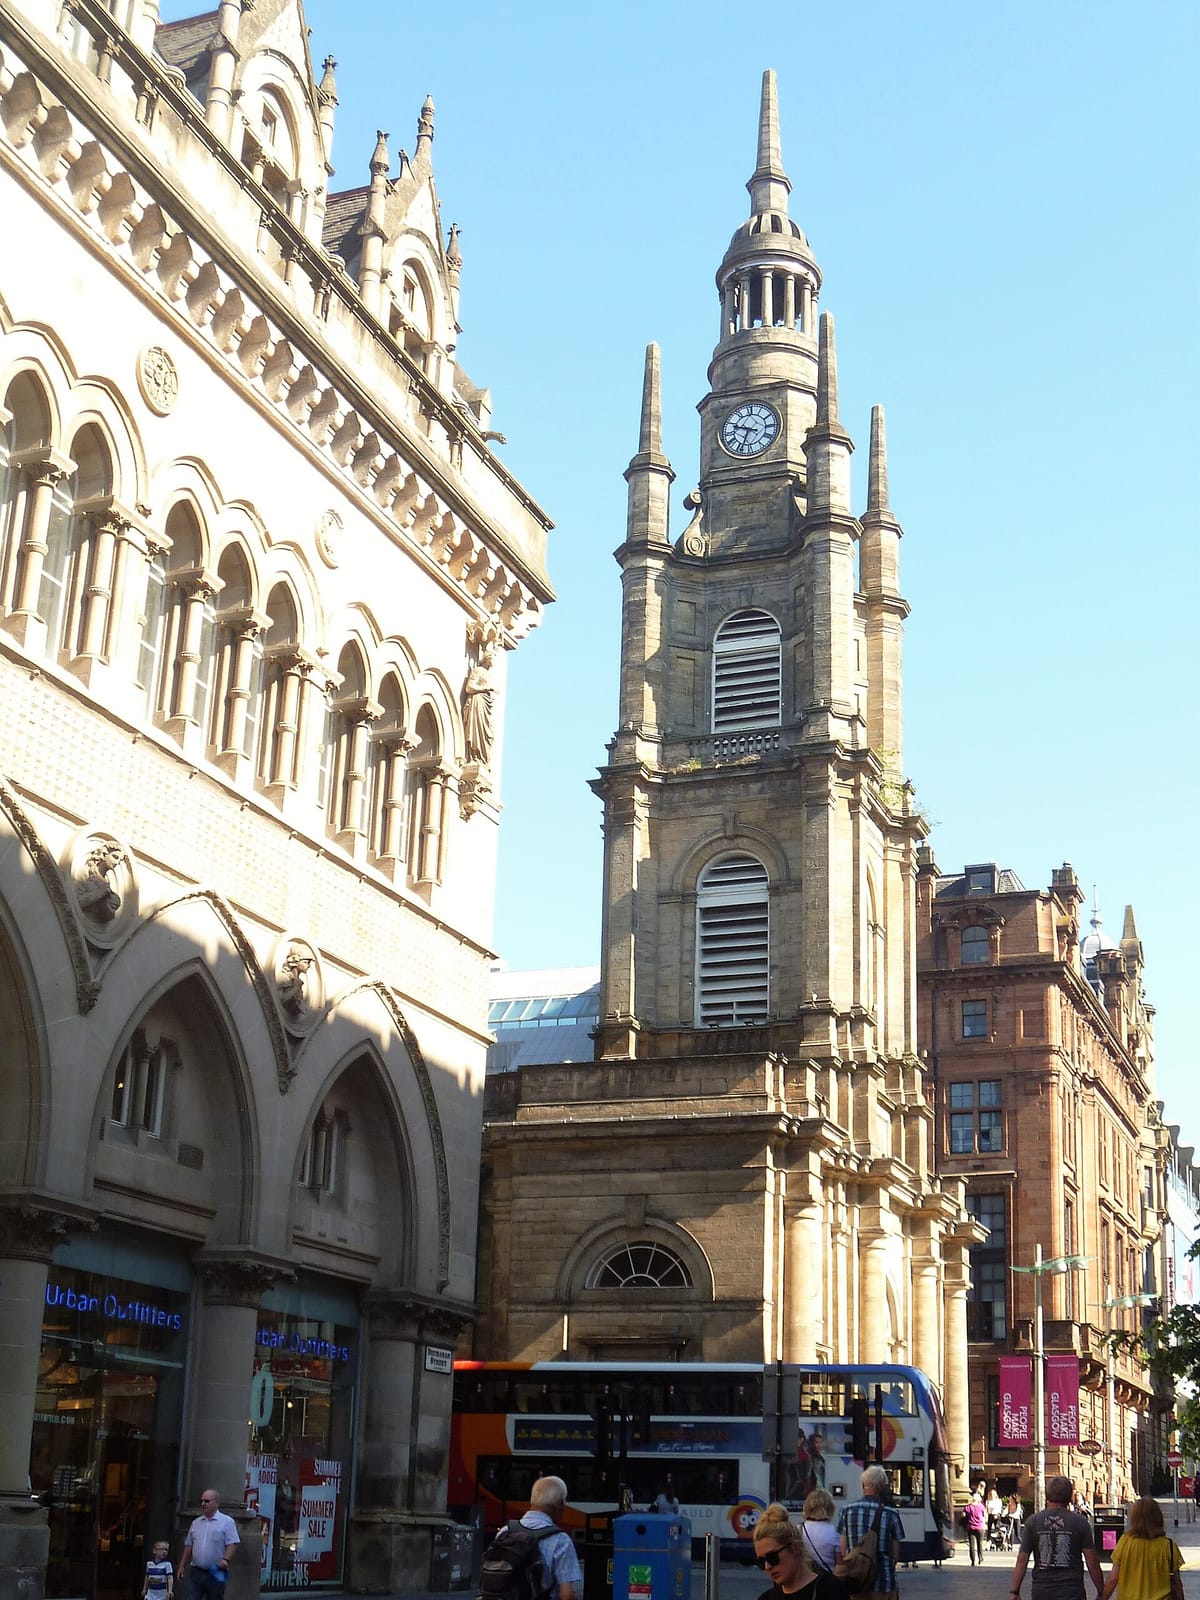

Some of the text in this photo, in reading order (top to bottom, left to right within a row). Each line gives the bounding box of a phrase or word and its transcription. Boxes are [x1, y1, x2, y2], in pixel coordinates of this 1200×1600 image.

[46, 1283, 99, 1312] Urban
[1003, 1393, 1012, 1440] GLASGOW
[1011, 1413, 1020, 1440] MAKE
[1019, 1405, 1028, 1439] PEOPLE
[1051, 1392, 1060, 1439] GLASGOW
[1060, 1412, 1069, 1439] MAKE
[1067, 1405, 1077, 1439] PEOPLE
[302, 1499, 334, 1519] SUMMER
[308, 1520, 326, 1538] SALE
